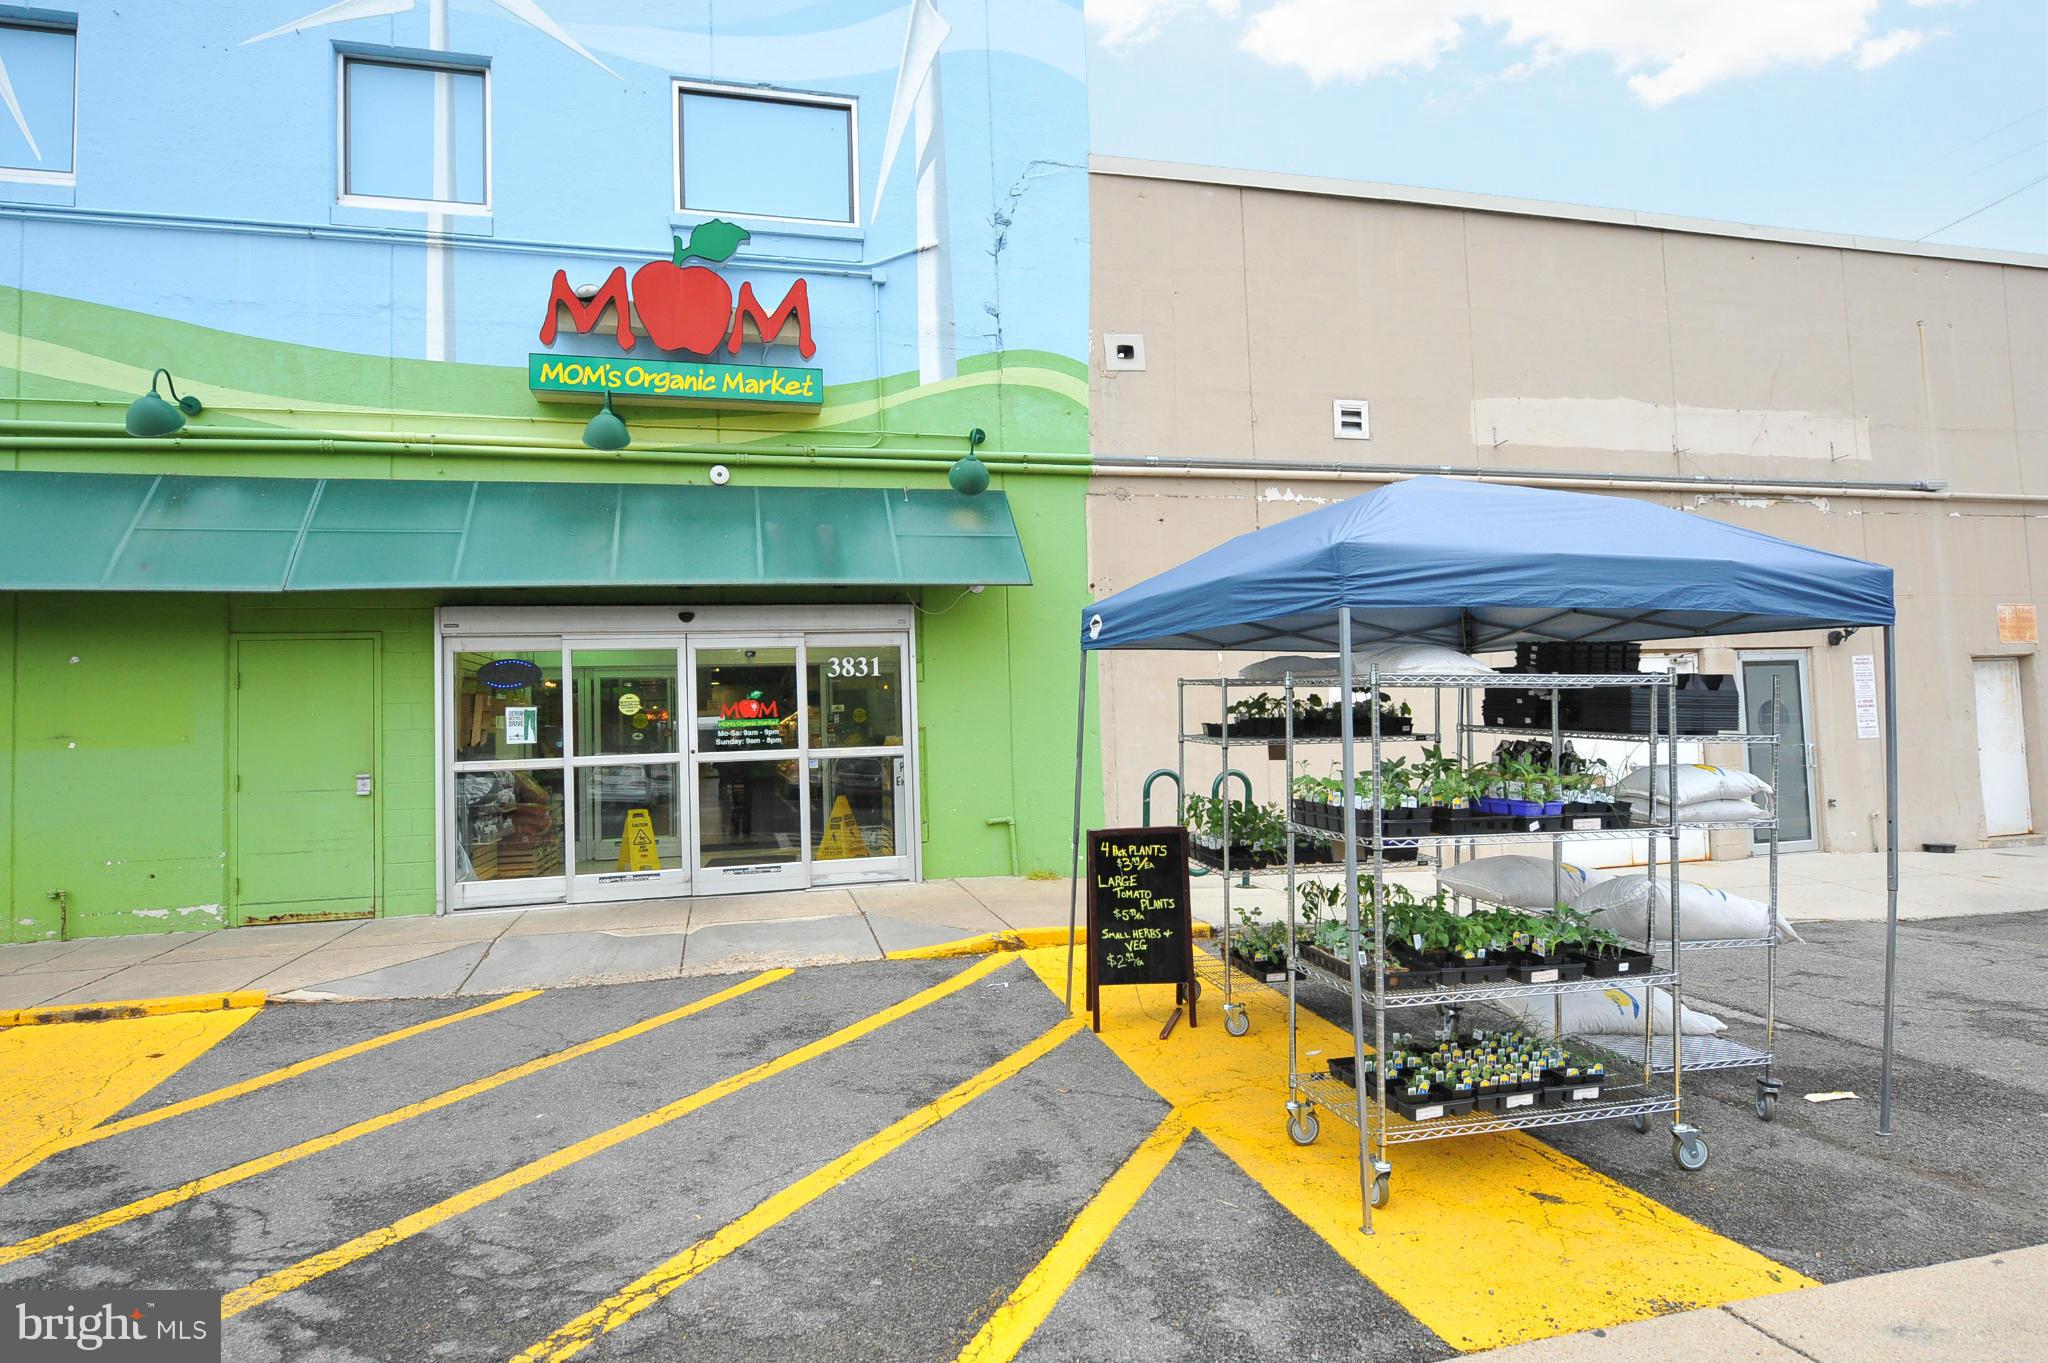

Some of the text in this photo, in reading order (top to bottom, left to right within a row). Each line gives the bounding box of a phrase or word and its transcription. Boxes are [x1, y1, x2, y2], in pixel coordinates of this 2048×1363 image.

[539, 259, 817, 359] MOM
[540, 362, 814, 397] MOM's Organic Market
[827, 656, 881, 678] 3831
[719, 699, 779, 719] MOM
[715, 738, 744, 746] Sunday:
[1101, 842, 1109, 857] 4
[1128, 845, 1167, 857] PLANTS
[1098, 874, 1138, 888] LARGE
[1140, 899, 1175, 911] PLANTS
[1132, 928, 1161, 939] HERBS
[1124, 939, 1148, 952] VEG
